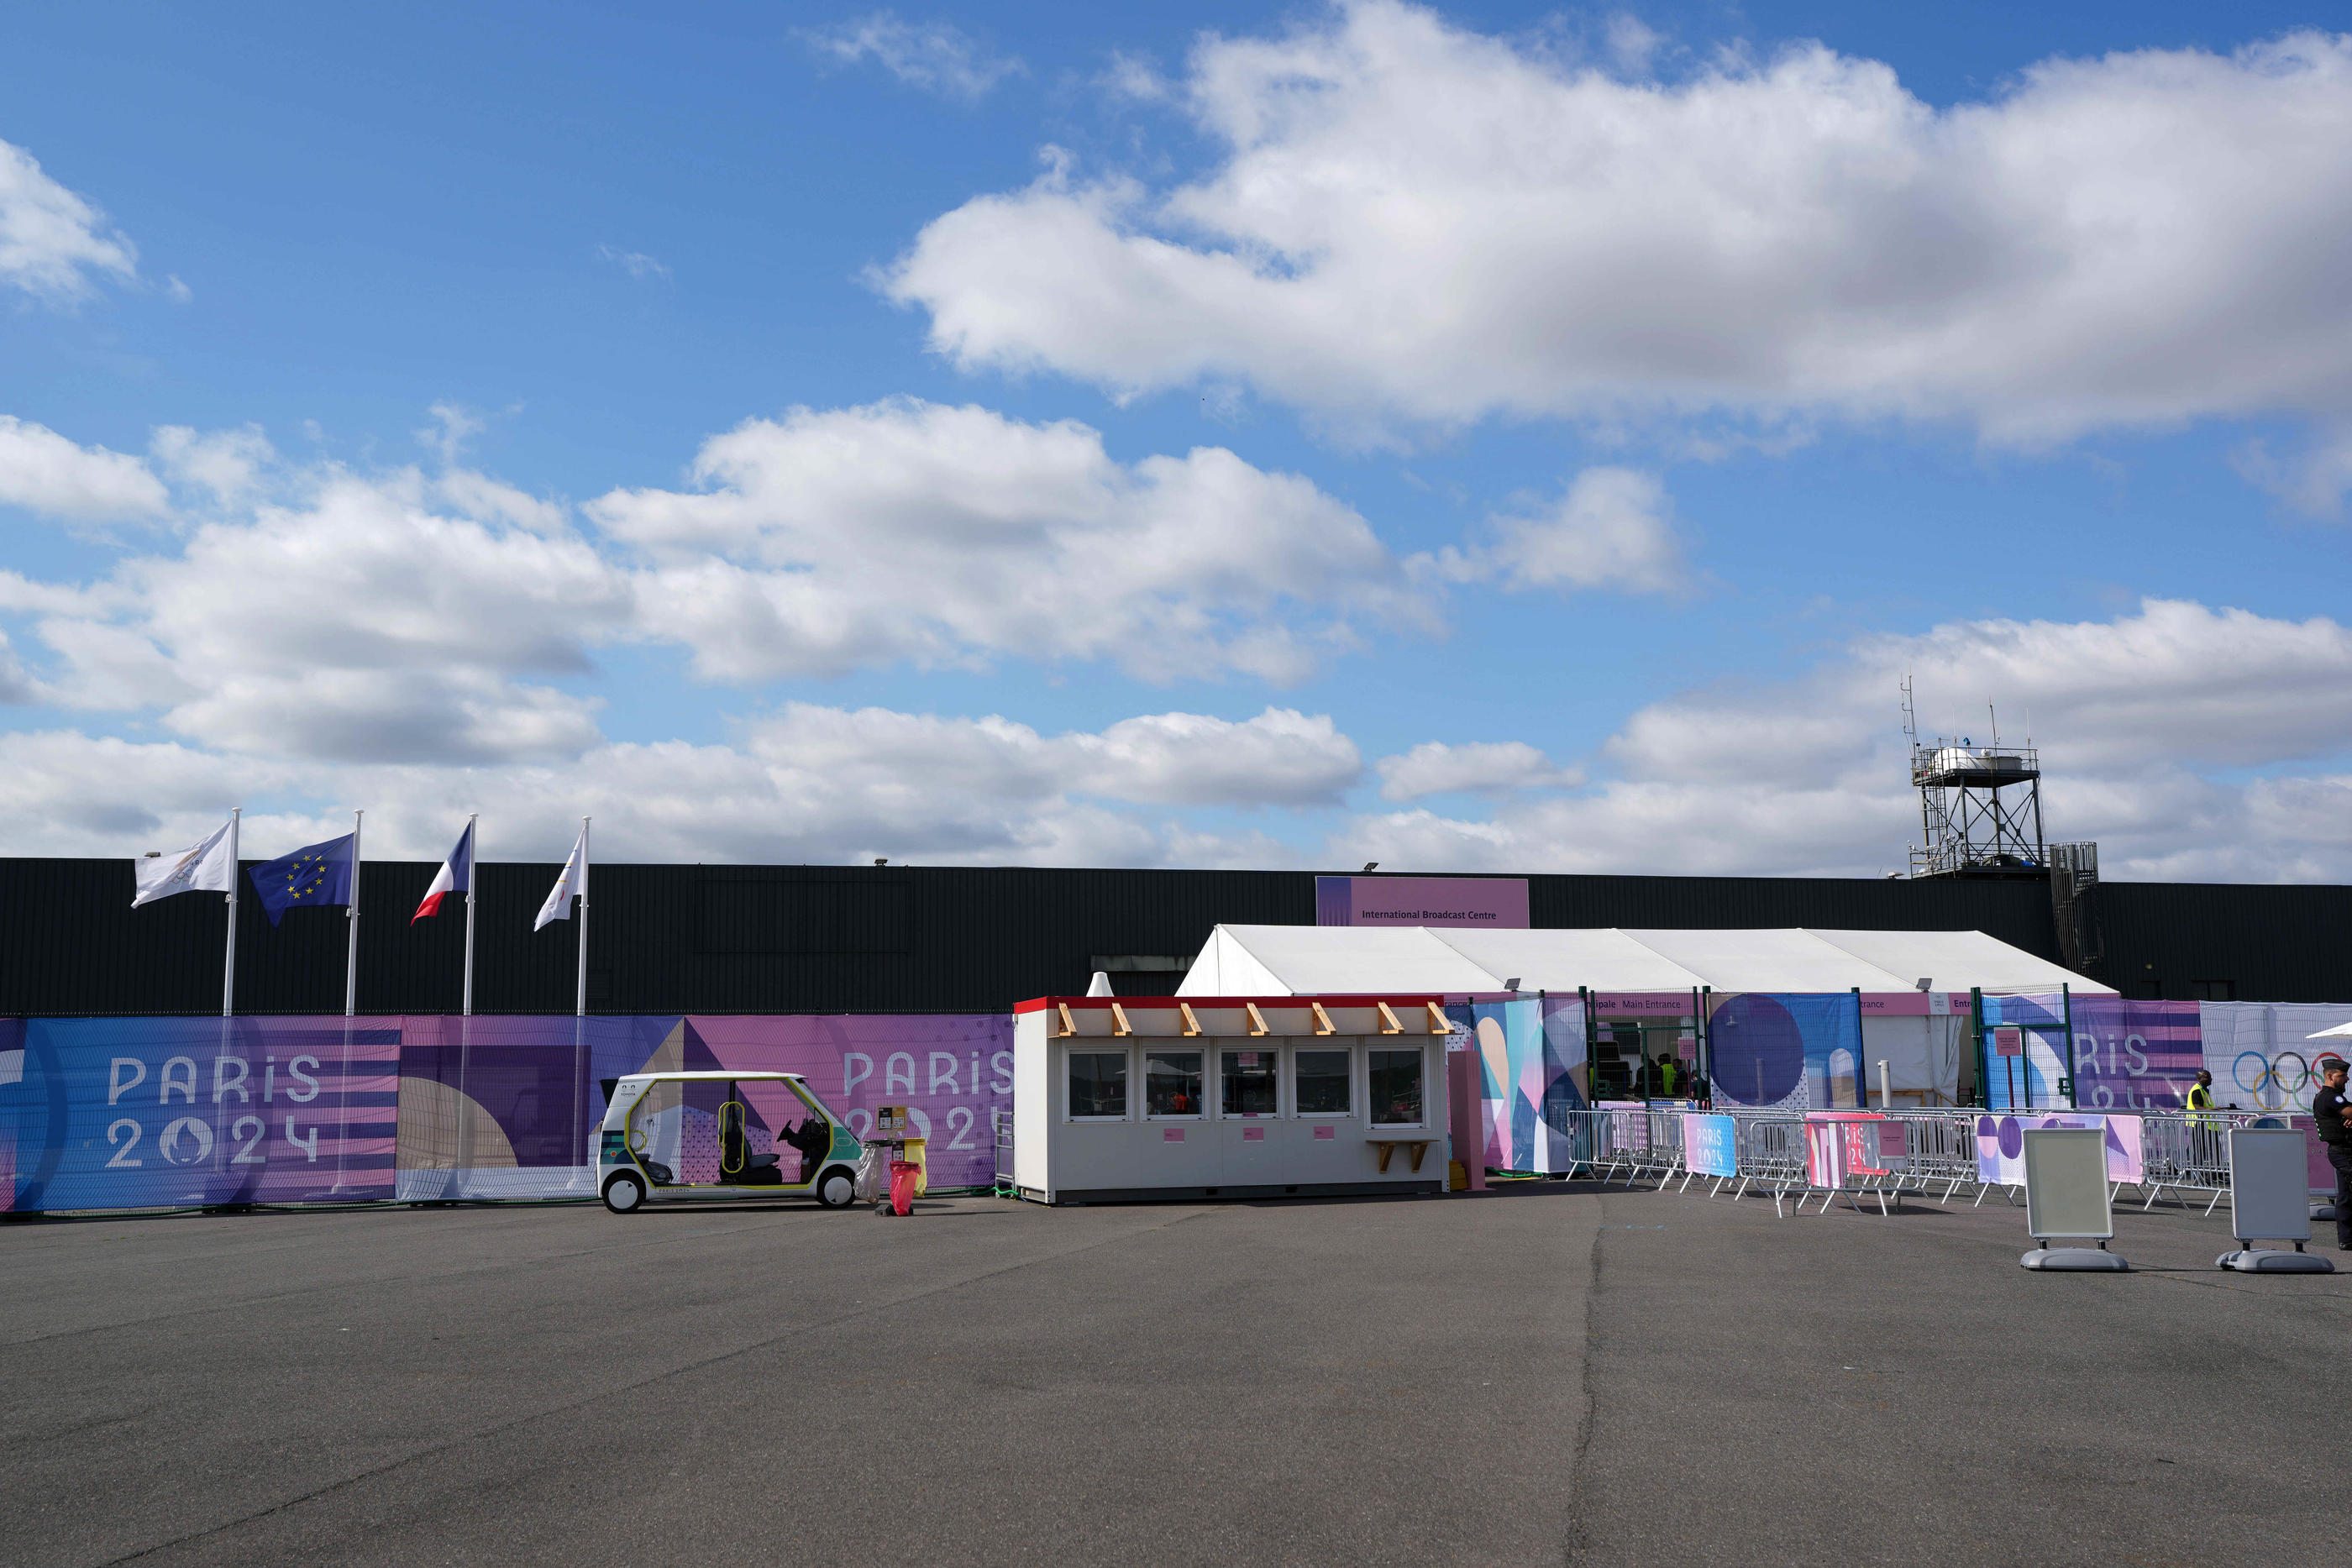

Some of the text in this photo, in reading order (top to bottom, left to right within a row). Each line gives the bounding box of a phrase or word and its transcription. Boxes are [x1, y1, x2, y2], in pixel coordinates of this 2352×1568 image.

[1362, 910, 1497, 920] International Broadcast Centre
[1623, 1000, 1643, 1009] Main
[1646, 1000, 1681, 1009] Entrance
[1698, 1148, 1723, 1167] 2024
